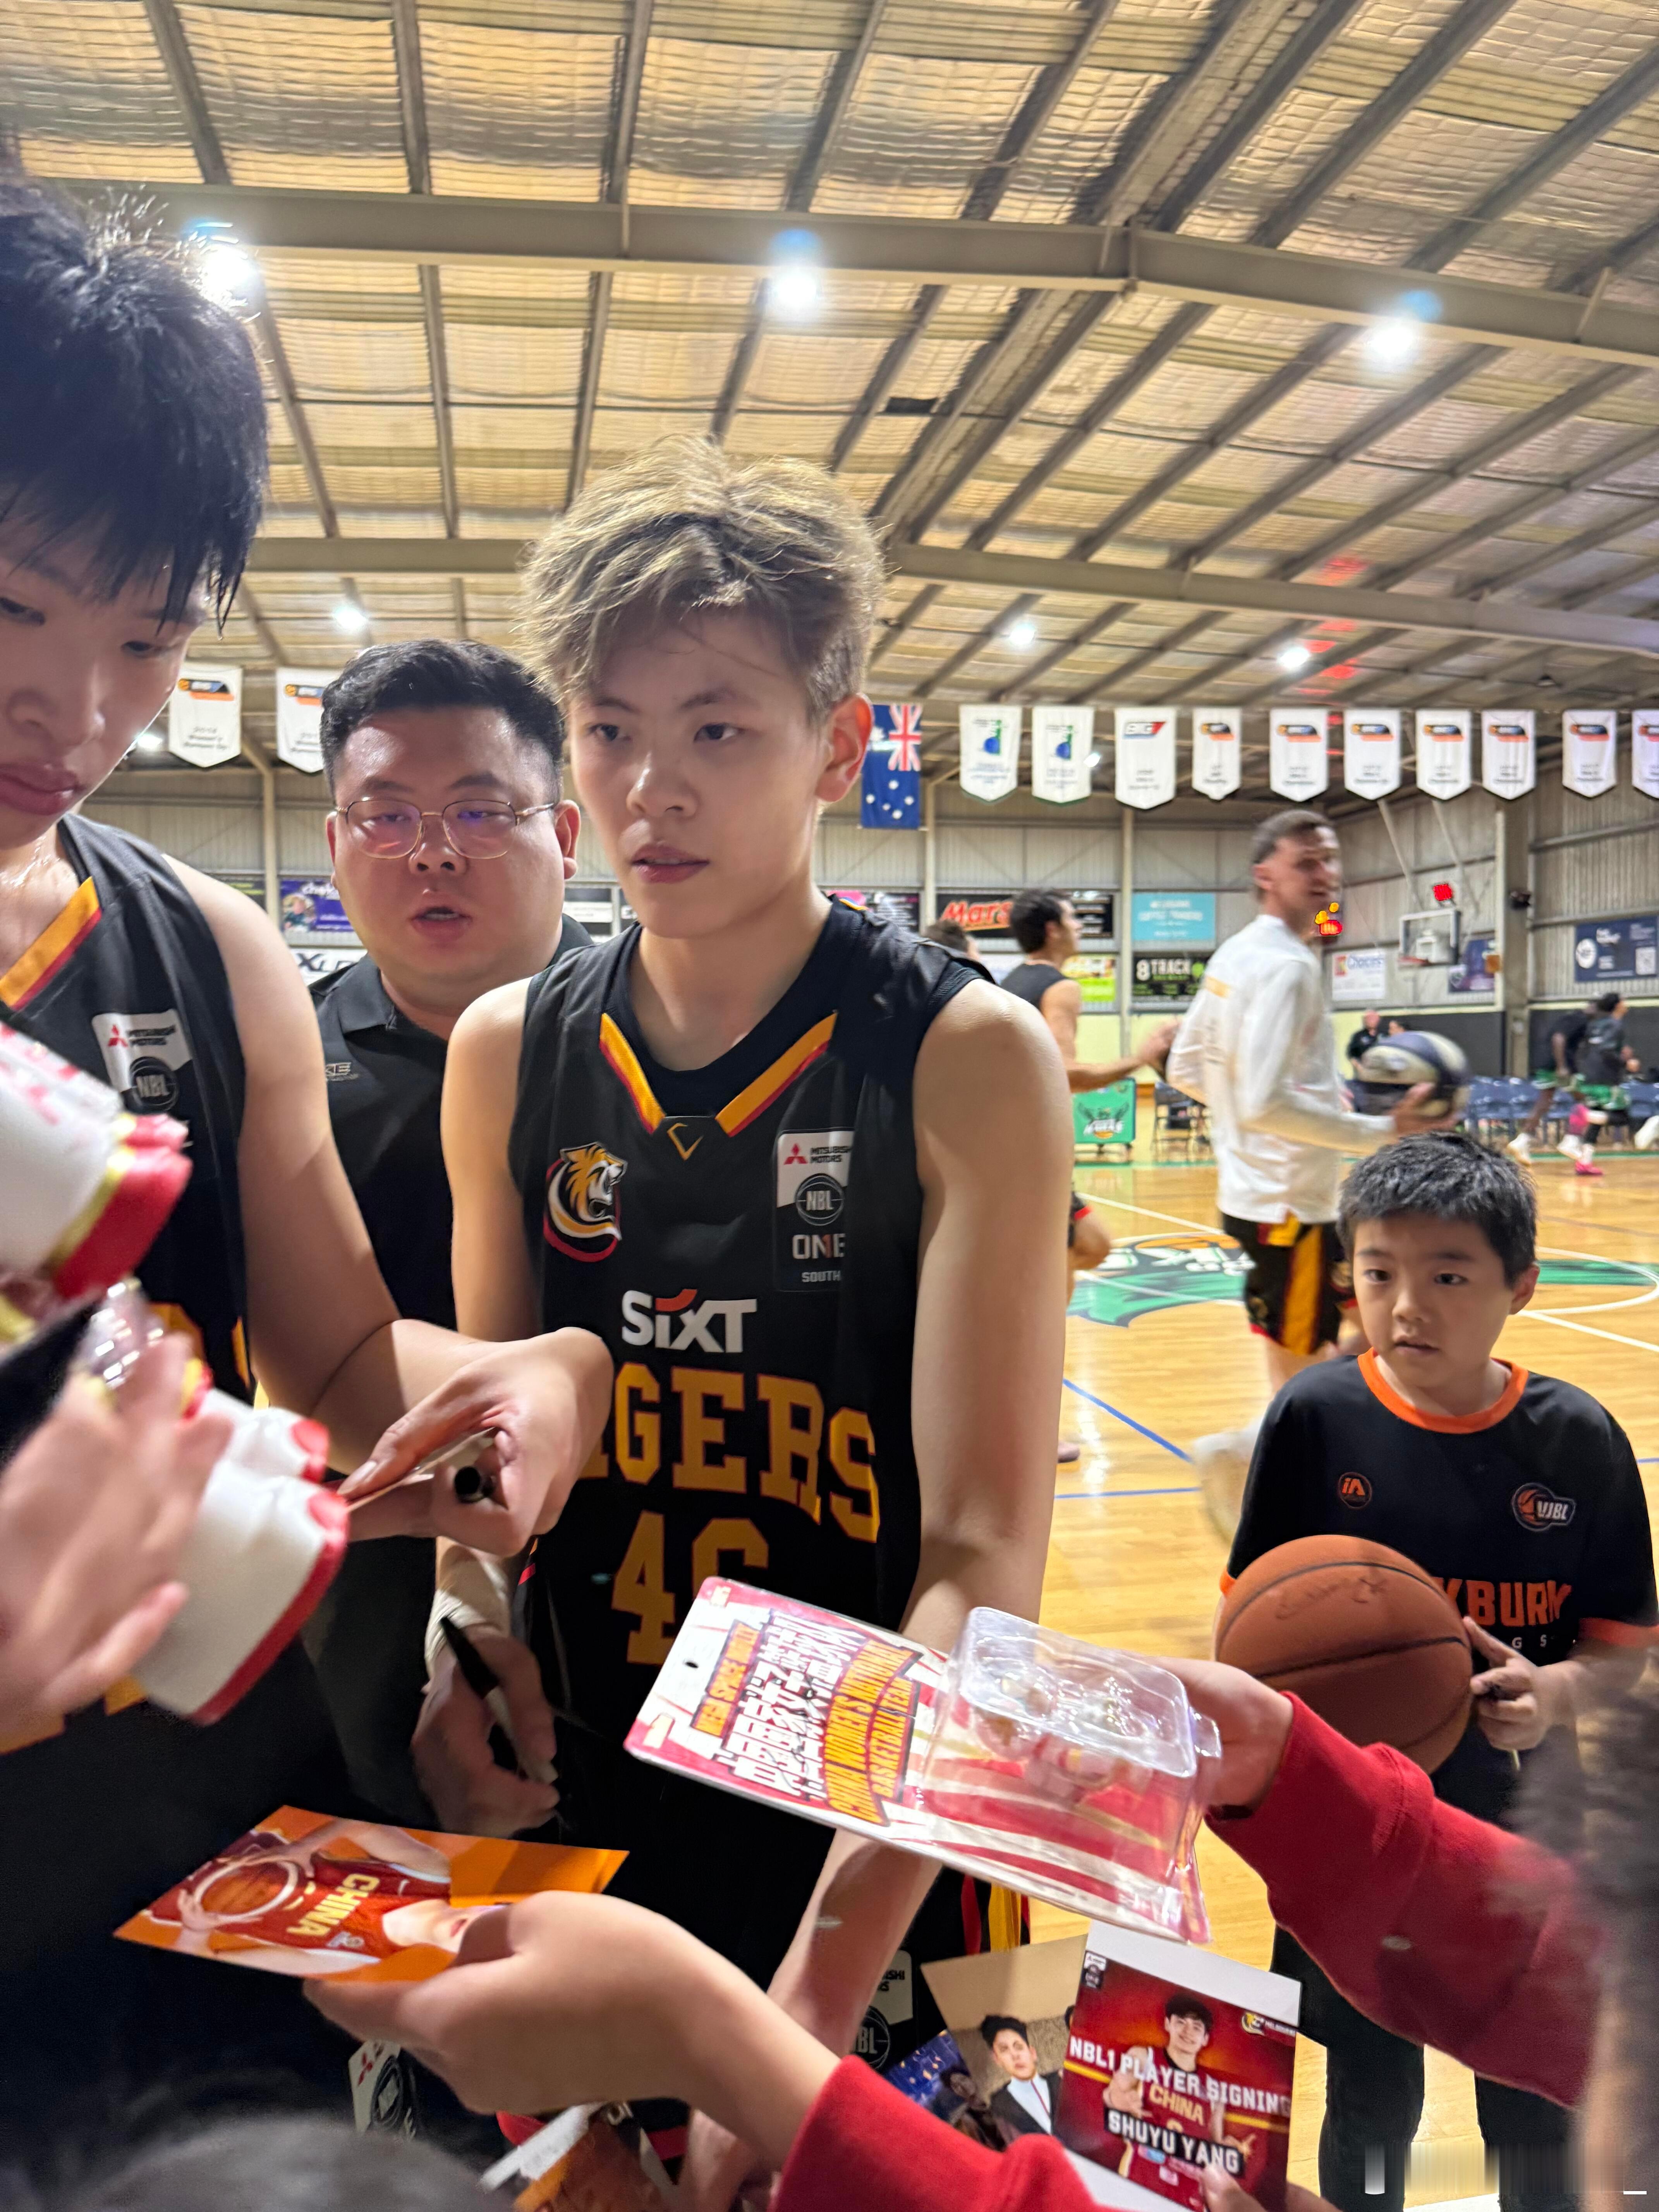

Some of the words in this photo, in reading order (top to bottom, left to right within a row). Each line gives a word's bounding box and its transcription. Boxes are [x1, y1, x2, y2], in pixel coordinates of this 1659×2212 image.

[1136, 959, 1151, 981] 8
[1151, 958, 1191, 975] TRACK
[811, 1155, 842, 1163] MOTORS
[806, 1190, 834, 1211] NBL
[802, 1270, 842, 1283] SOUTH
[577, 1361, 881, 1543] GERS
[838, 1639, 914, 1704] NATIONAL
[879, 1677, 913, 1713] TEAM
[716, 1611, 867, 1799] 中国国家女子篮球队
[869, 1710, 907, 1798] BASKETBALL
[824, 1763, 883, 1824] CHINA
[287, 1873, 379, 1936] CHINA
[852, 2026, 878, 2054] BL
[1069, 2035, 1115, 2071] NBL1
[1120, 2053, 1202, 2097] PLAYER
[1206, 2076, 1292, 2118] SIGNING
[1149, 2084, 1204, 2126] CHINA
[1108, 2109, 1177, 2155] SHUYU
[1182, 2135, 1240, 2175] YANG
